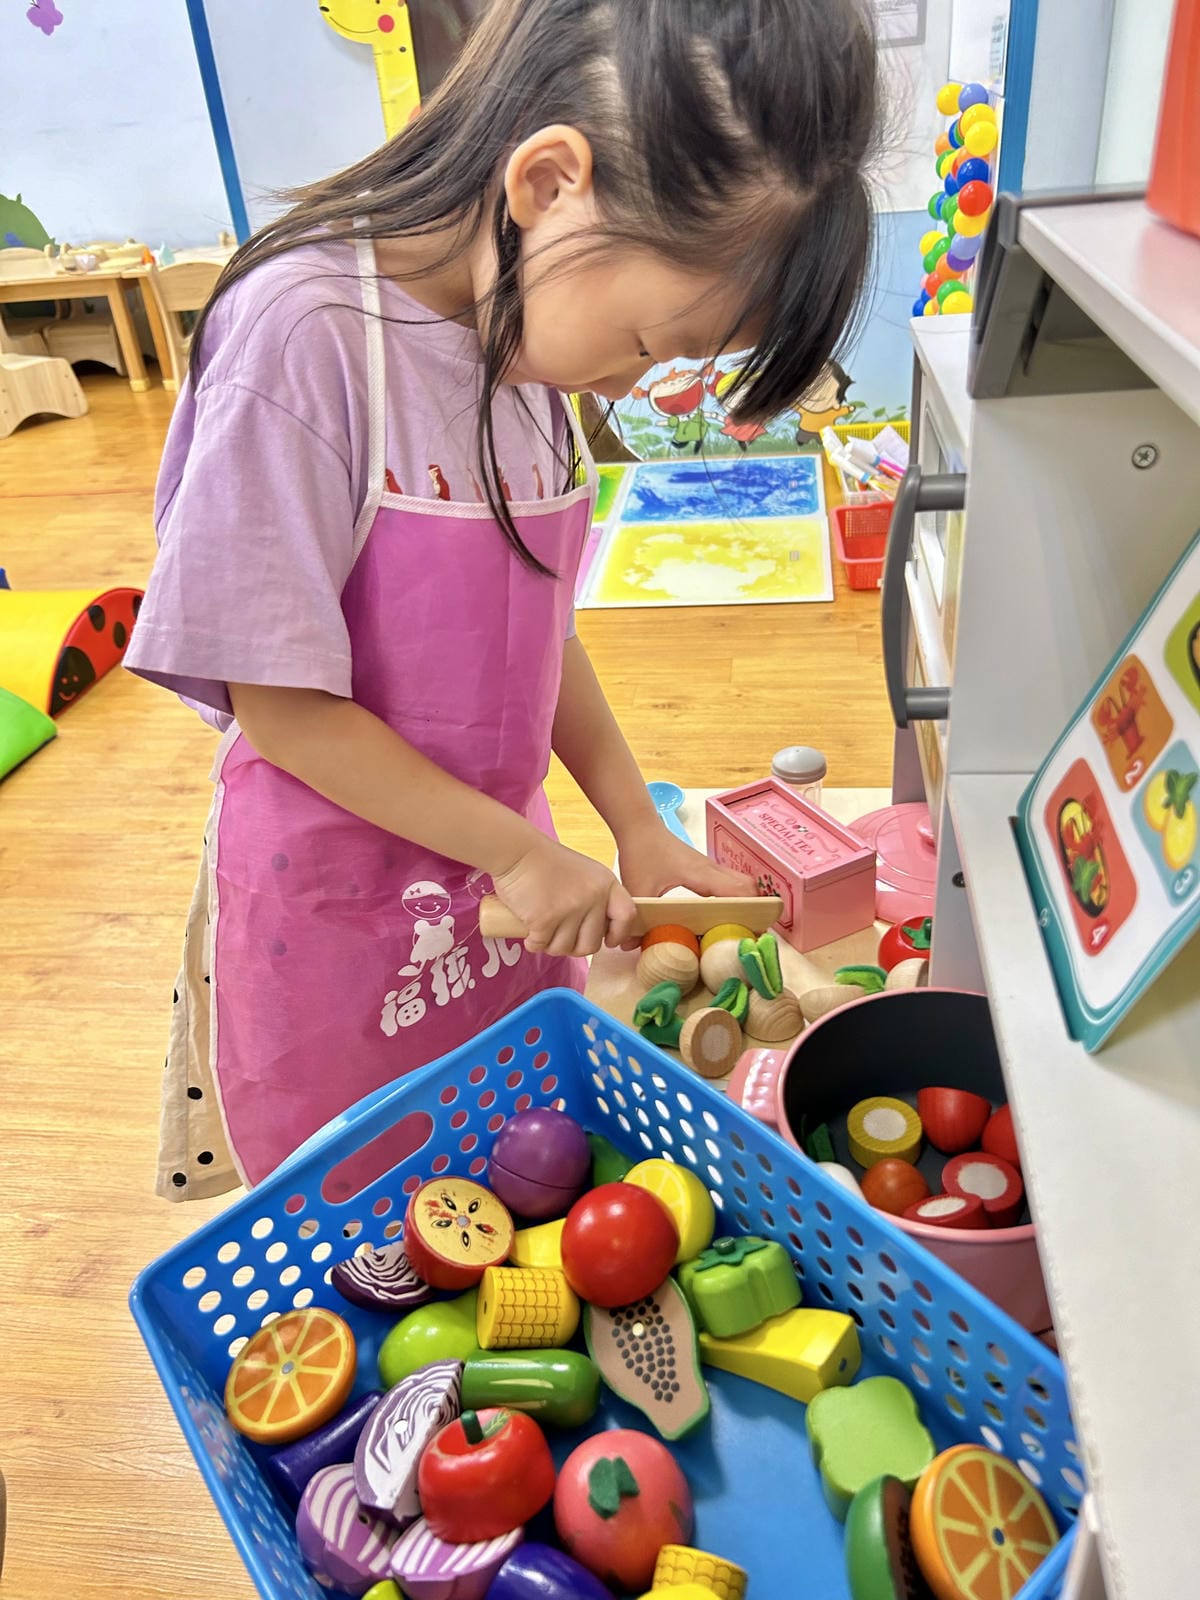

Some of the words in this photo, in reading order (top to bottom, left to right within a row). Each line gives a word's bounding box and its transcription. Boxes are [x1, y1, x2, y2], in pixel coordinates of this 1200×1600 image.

[1125, 760, 1143, 784] 2
[759, 813, 796, 842] SPECIAL
[794, 840, 815, 856] TEA
[1174, 869, 1193, 895] 3
[1091, 924, 1108, 946] 4
